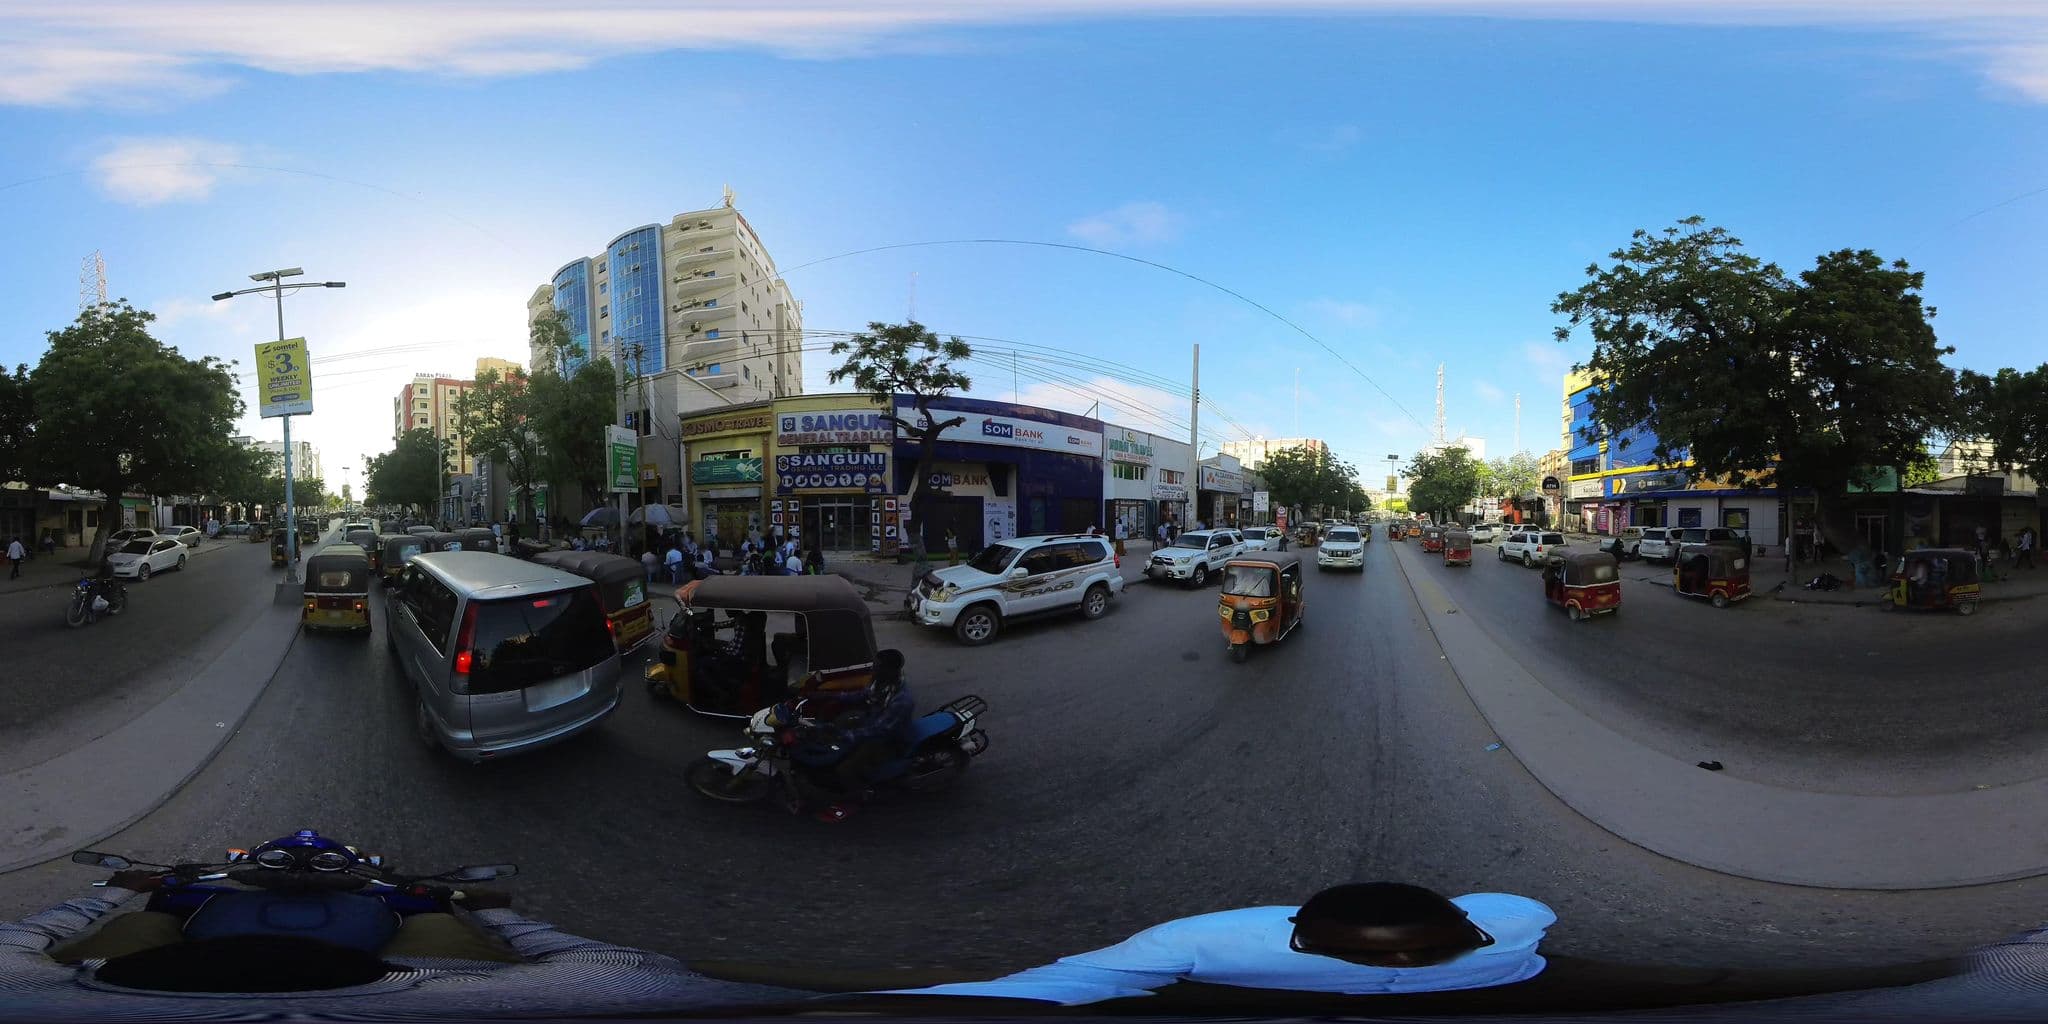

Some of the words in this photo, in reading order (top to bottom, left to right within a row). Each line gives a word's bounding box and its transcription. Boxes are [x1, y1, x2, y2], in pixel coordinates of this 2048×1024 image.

[272, 342, 298, 352] somtel
[269, 374, 298, 382] WEEKLY
[985, 424, 1011, 436] SOM
[1015, 428, 1043, 440] BANK
[790, 454, 884, 467] SANGUNI
[953, 475, 988, 486] BANK
[1020, 580, 1074, 598] PRADO
